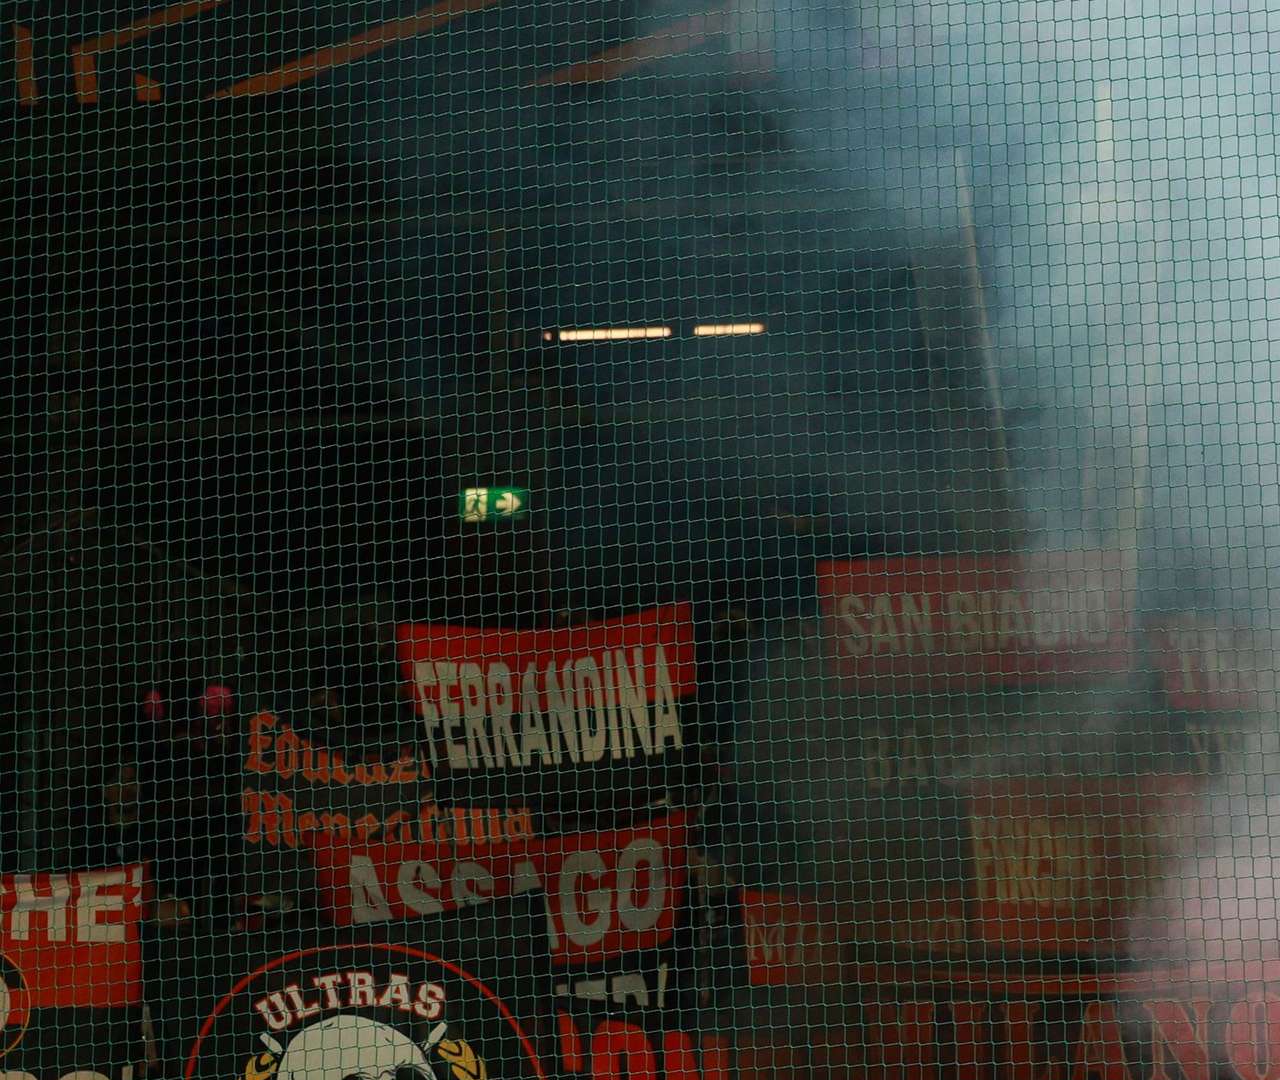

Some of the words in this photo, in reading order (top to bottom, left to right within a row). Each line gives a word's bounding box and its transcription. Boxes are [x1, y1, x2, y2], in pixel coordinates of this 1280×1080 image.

[838, 590, 932, 657] SAN
[413, 643, 684, 772] FERRANDINA
[254, 970, 446, 1032] ULTRAS
